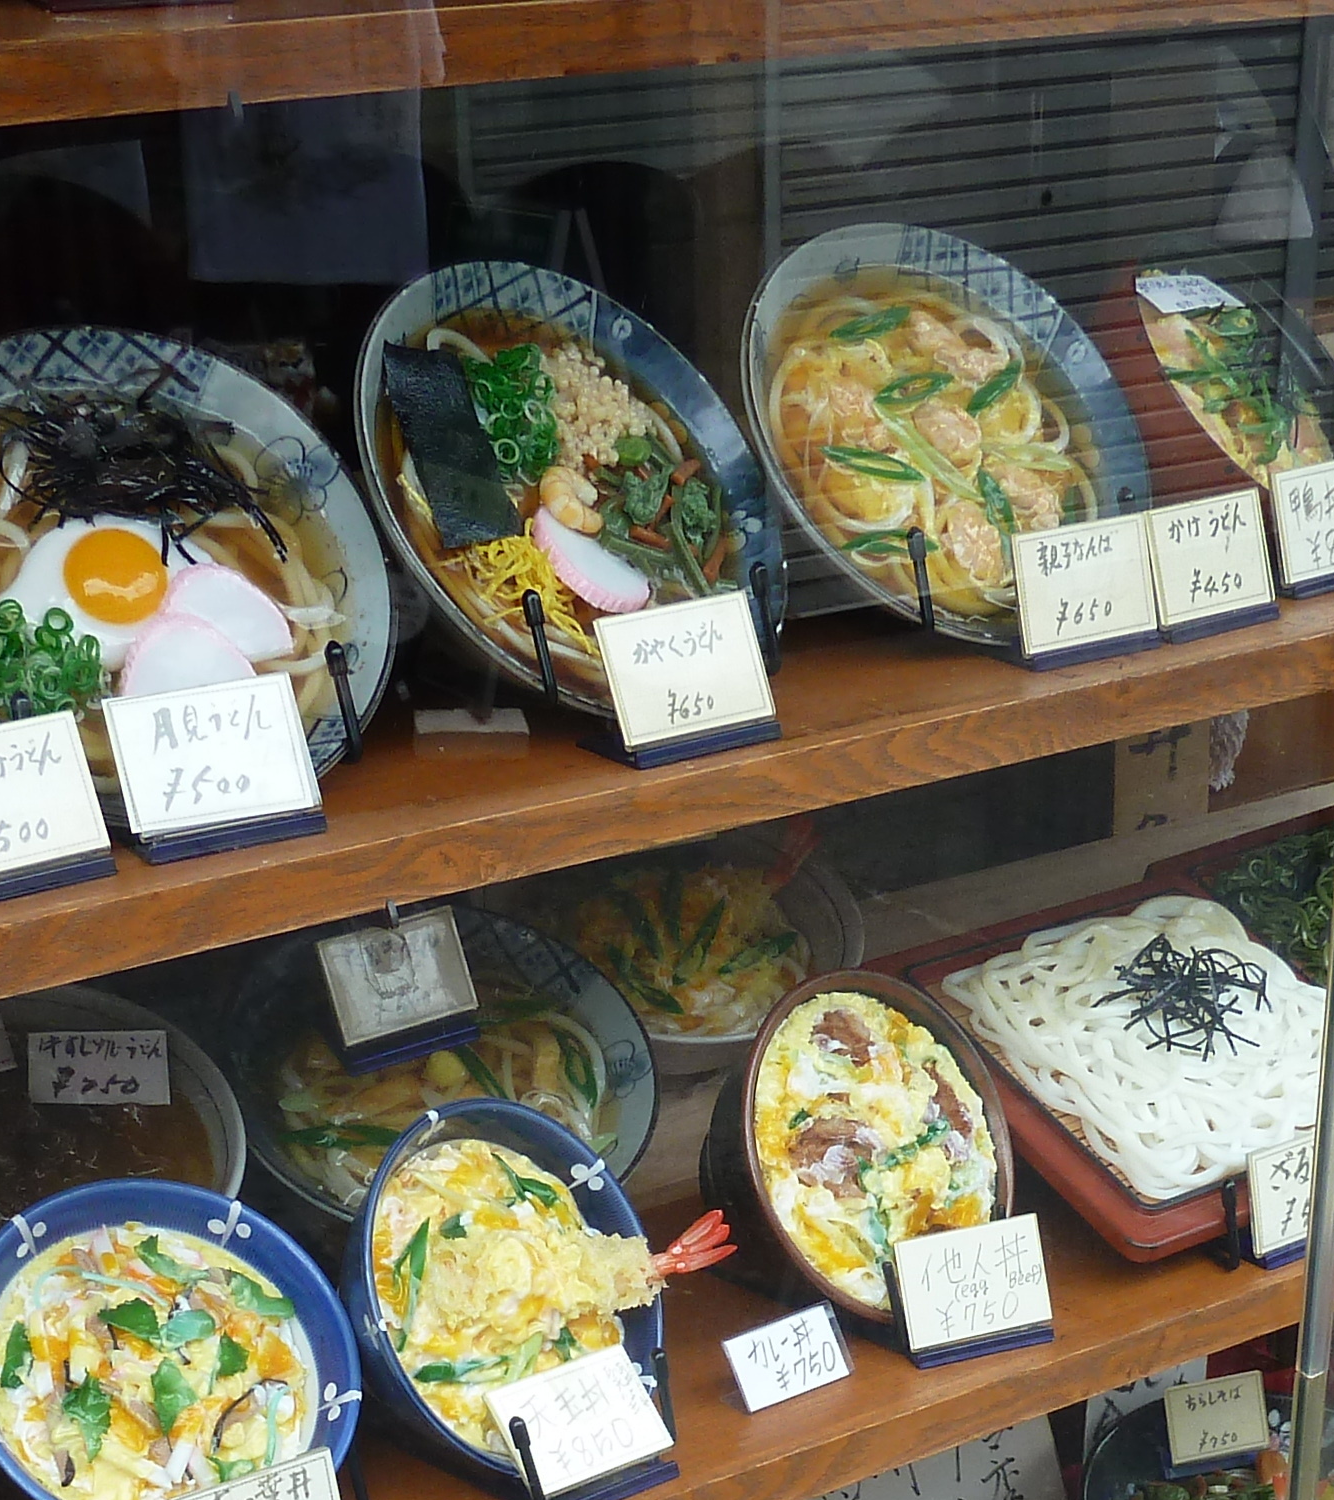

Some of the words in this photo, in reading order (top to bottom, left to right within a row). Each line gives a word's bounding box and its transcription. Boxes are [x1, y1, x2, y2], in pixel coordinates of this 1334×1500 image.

[1189, 570, 1243, 603] ¥450
[1055, 599, 1112, 636] ¥650
[667, 689, 714, 725] ¥650
[162, 766, 250, 812] ¥500
[921, 1233, 1028, 1291] 他人丼
[935, 1291, 1019, 1339] ¥750
[775, 1341, 836, 1392] ¥750
[547, 1417, 635, 1478] ¥850
